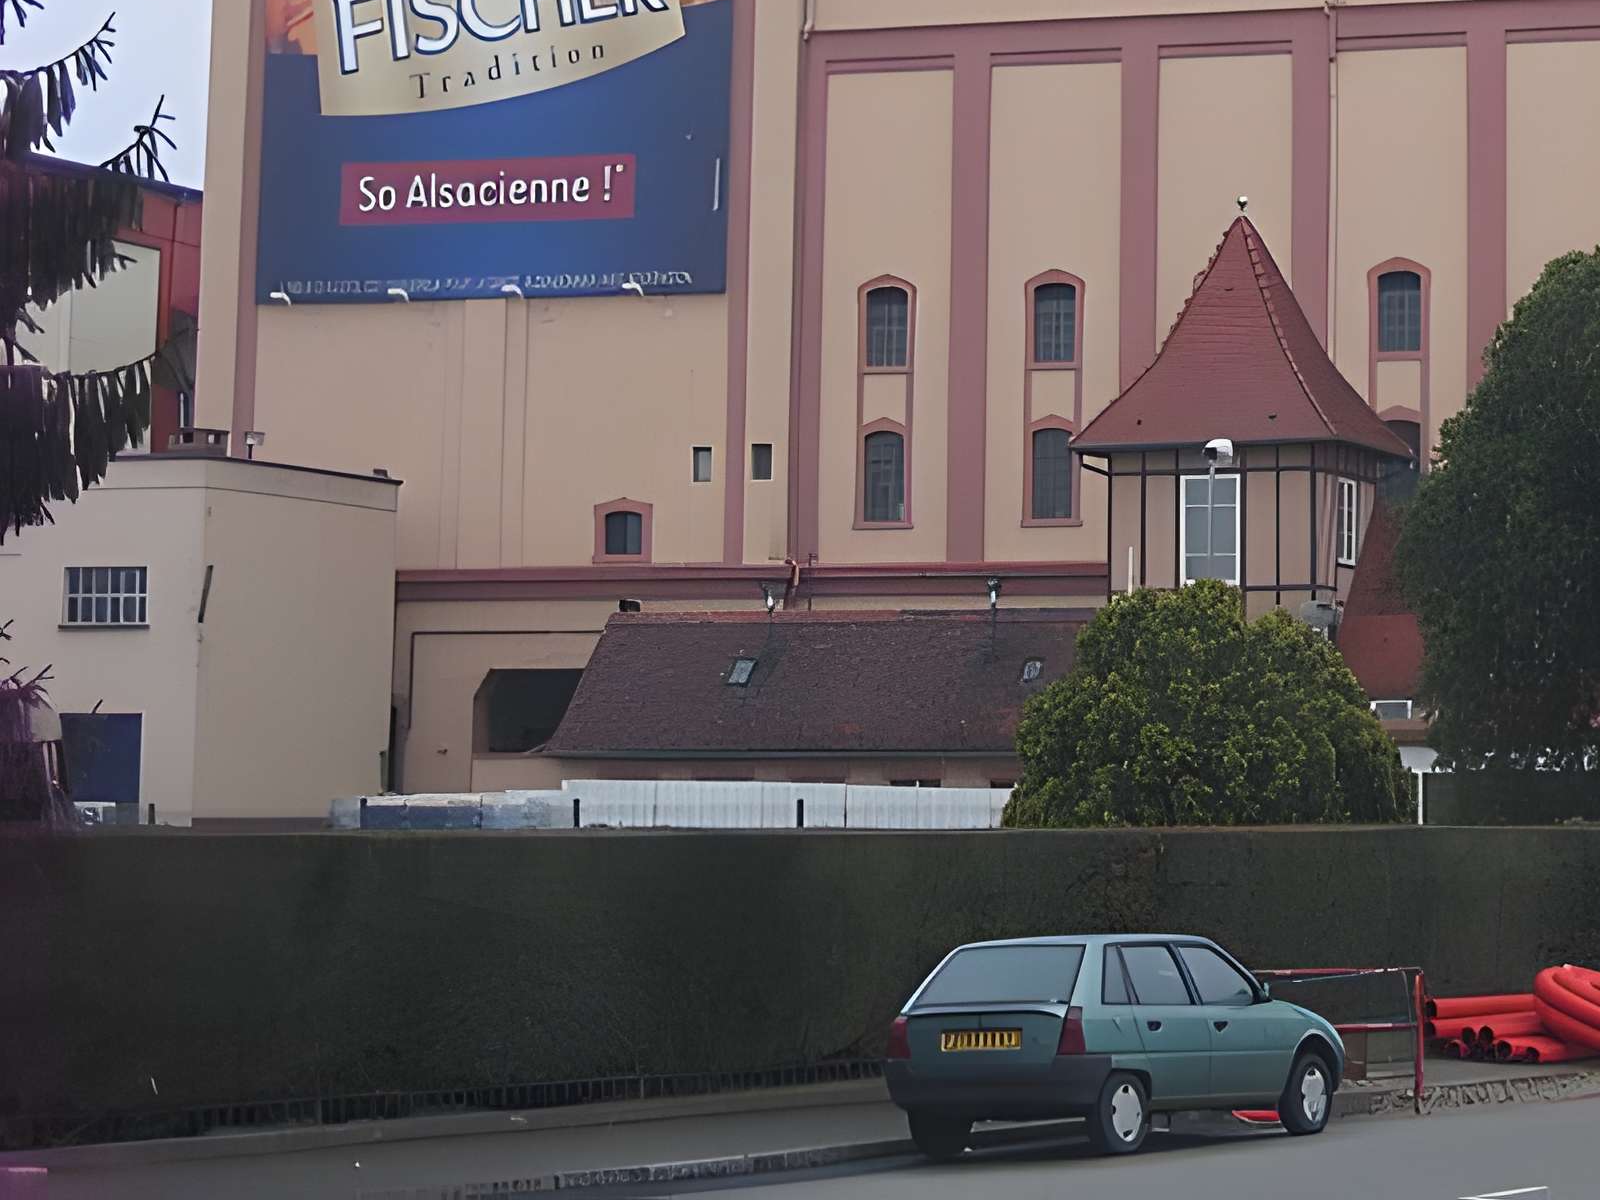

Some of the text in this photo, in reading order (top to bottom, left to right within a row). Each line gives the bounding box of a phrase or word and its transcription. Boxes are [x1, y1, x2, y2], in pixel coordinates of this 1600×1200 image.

[408, 43, 606, 99] Tradition
[358, 175, 397, 213] So
[405, 171, 590, 209] Alsacienne
